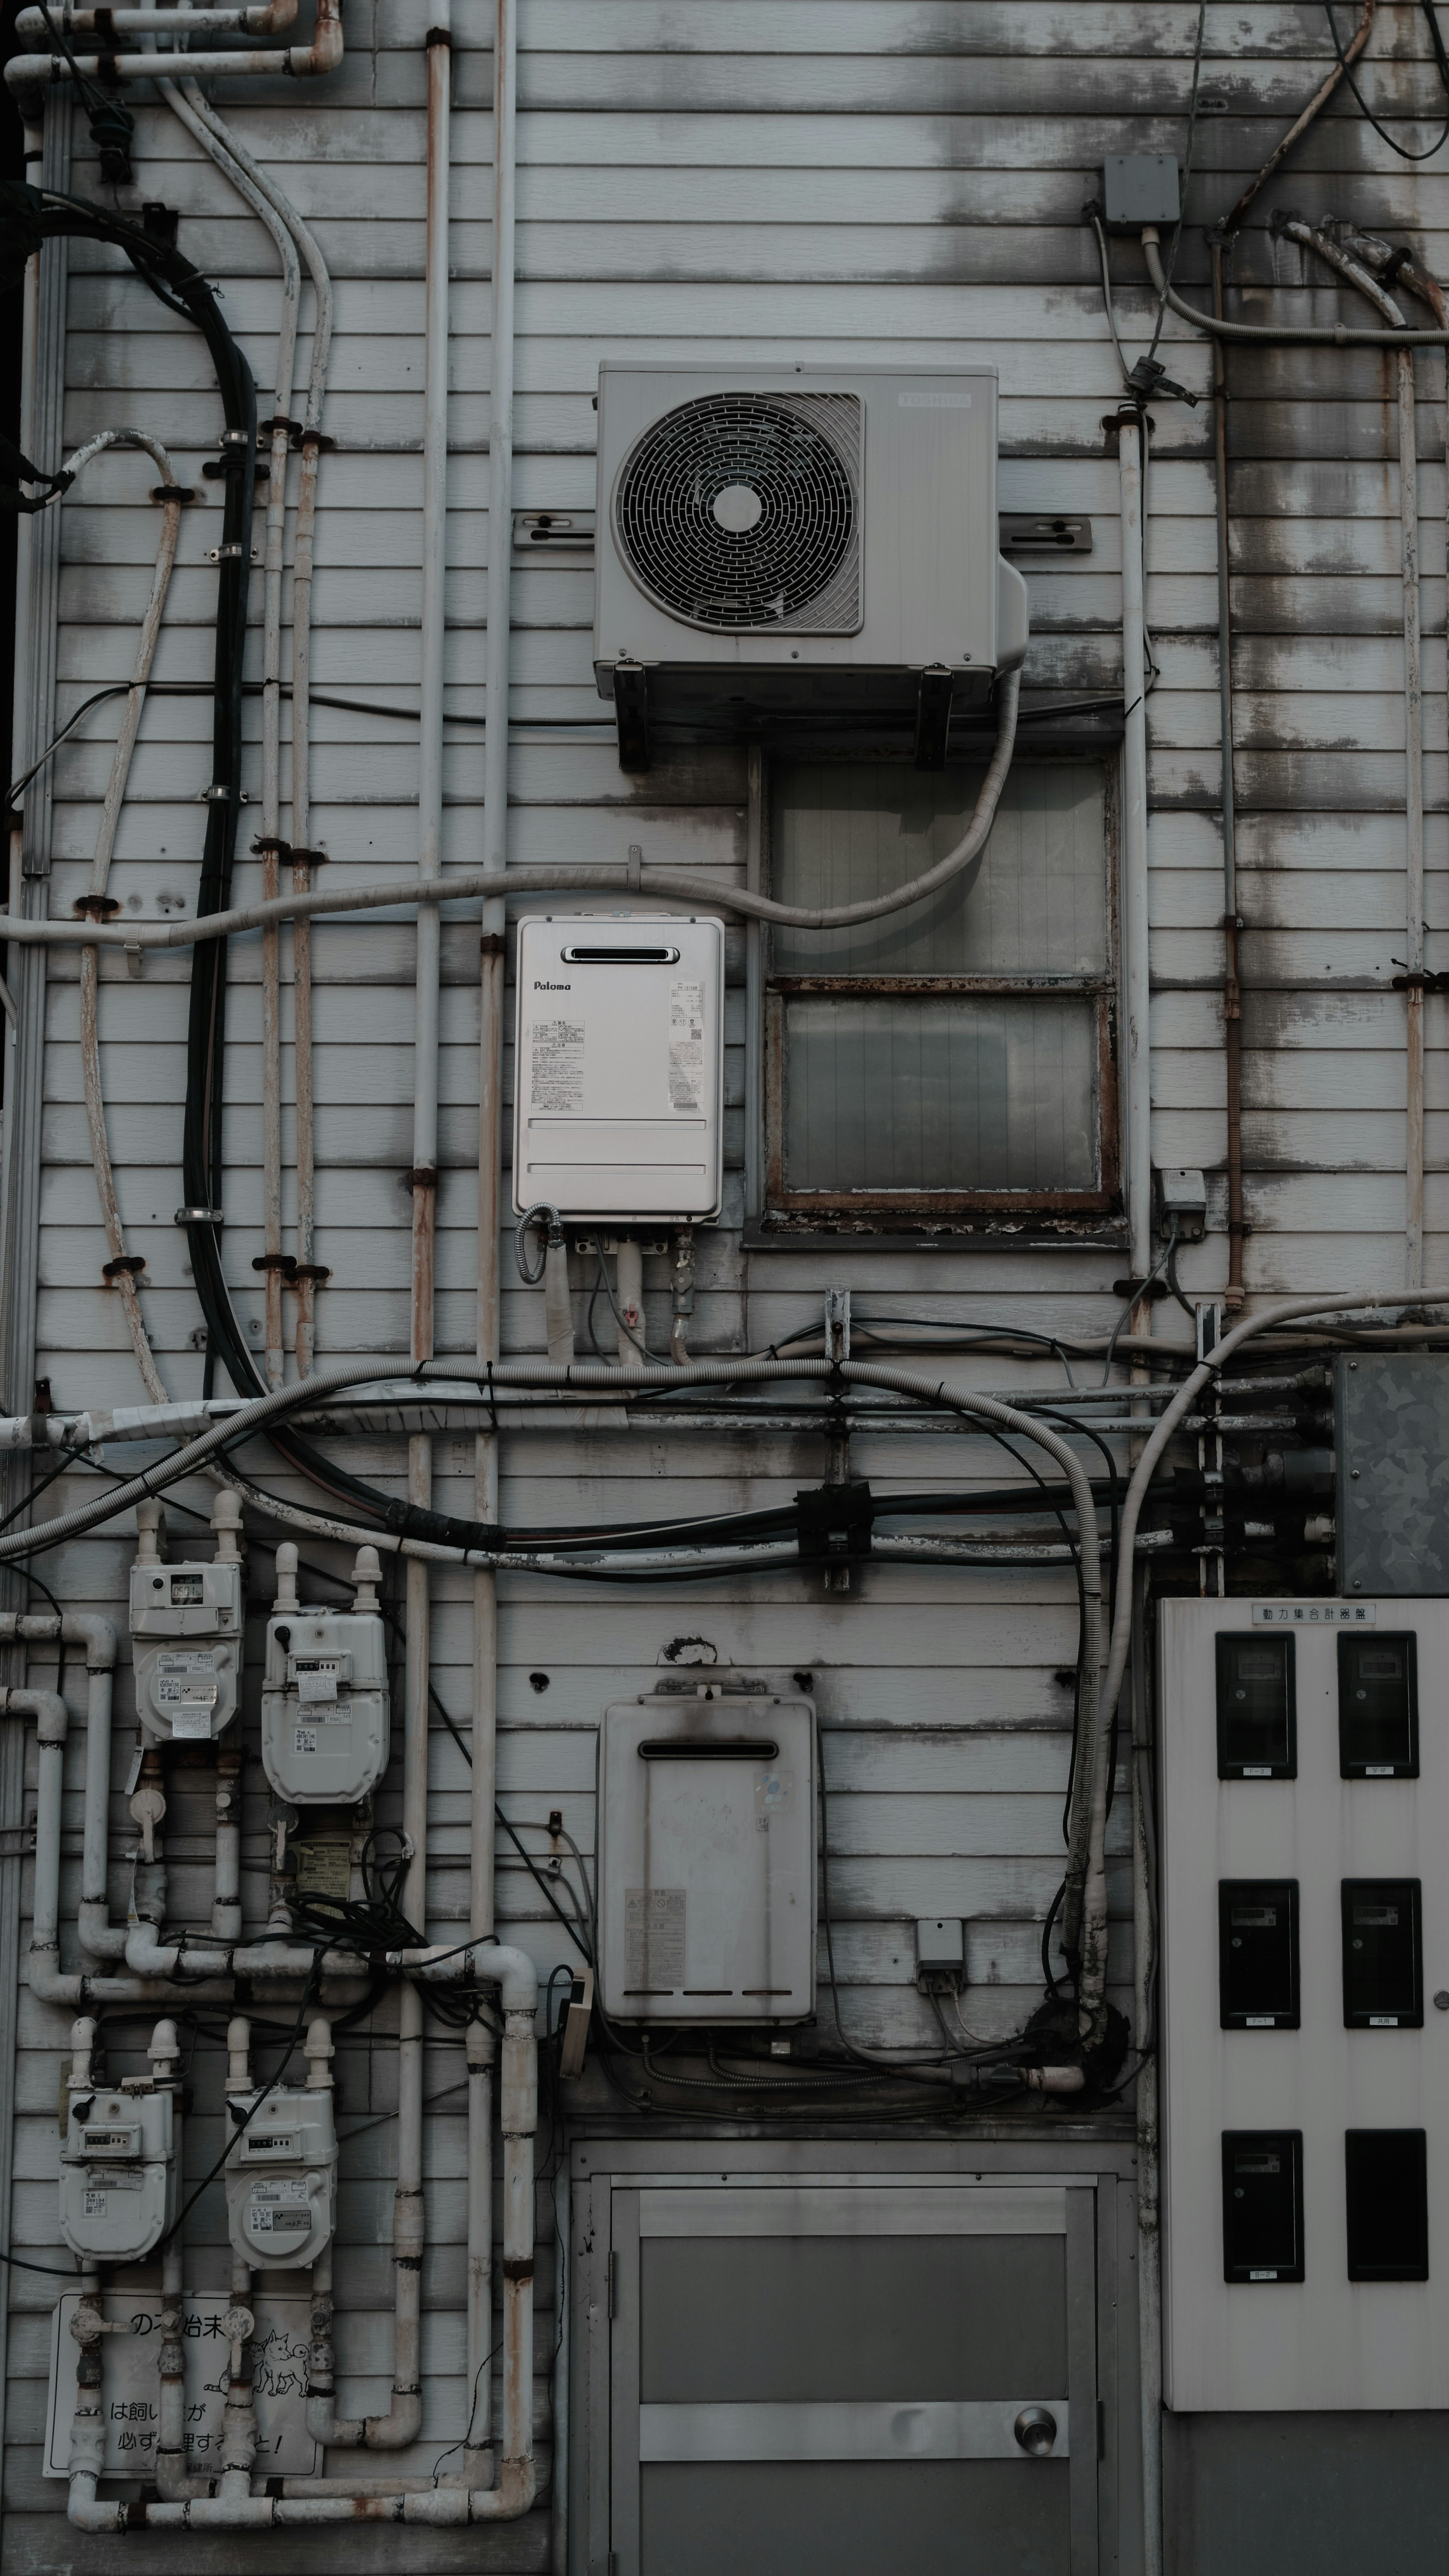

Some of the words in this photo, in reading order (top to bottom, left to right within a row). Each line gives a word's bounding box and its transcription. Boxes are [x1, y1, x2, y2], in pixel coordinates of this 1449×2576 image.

[902, 395, 969, 405] TOSHIBA
[534, 981, 571, 990] Paloma
[1263, 1608, 1365, 1620] 動力集合計器盤
